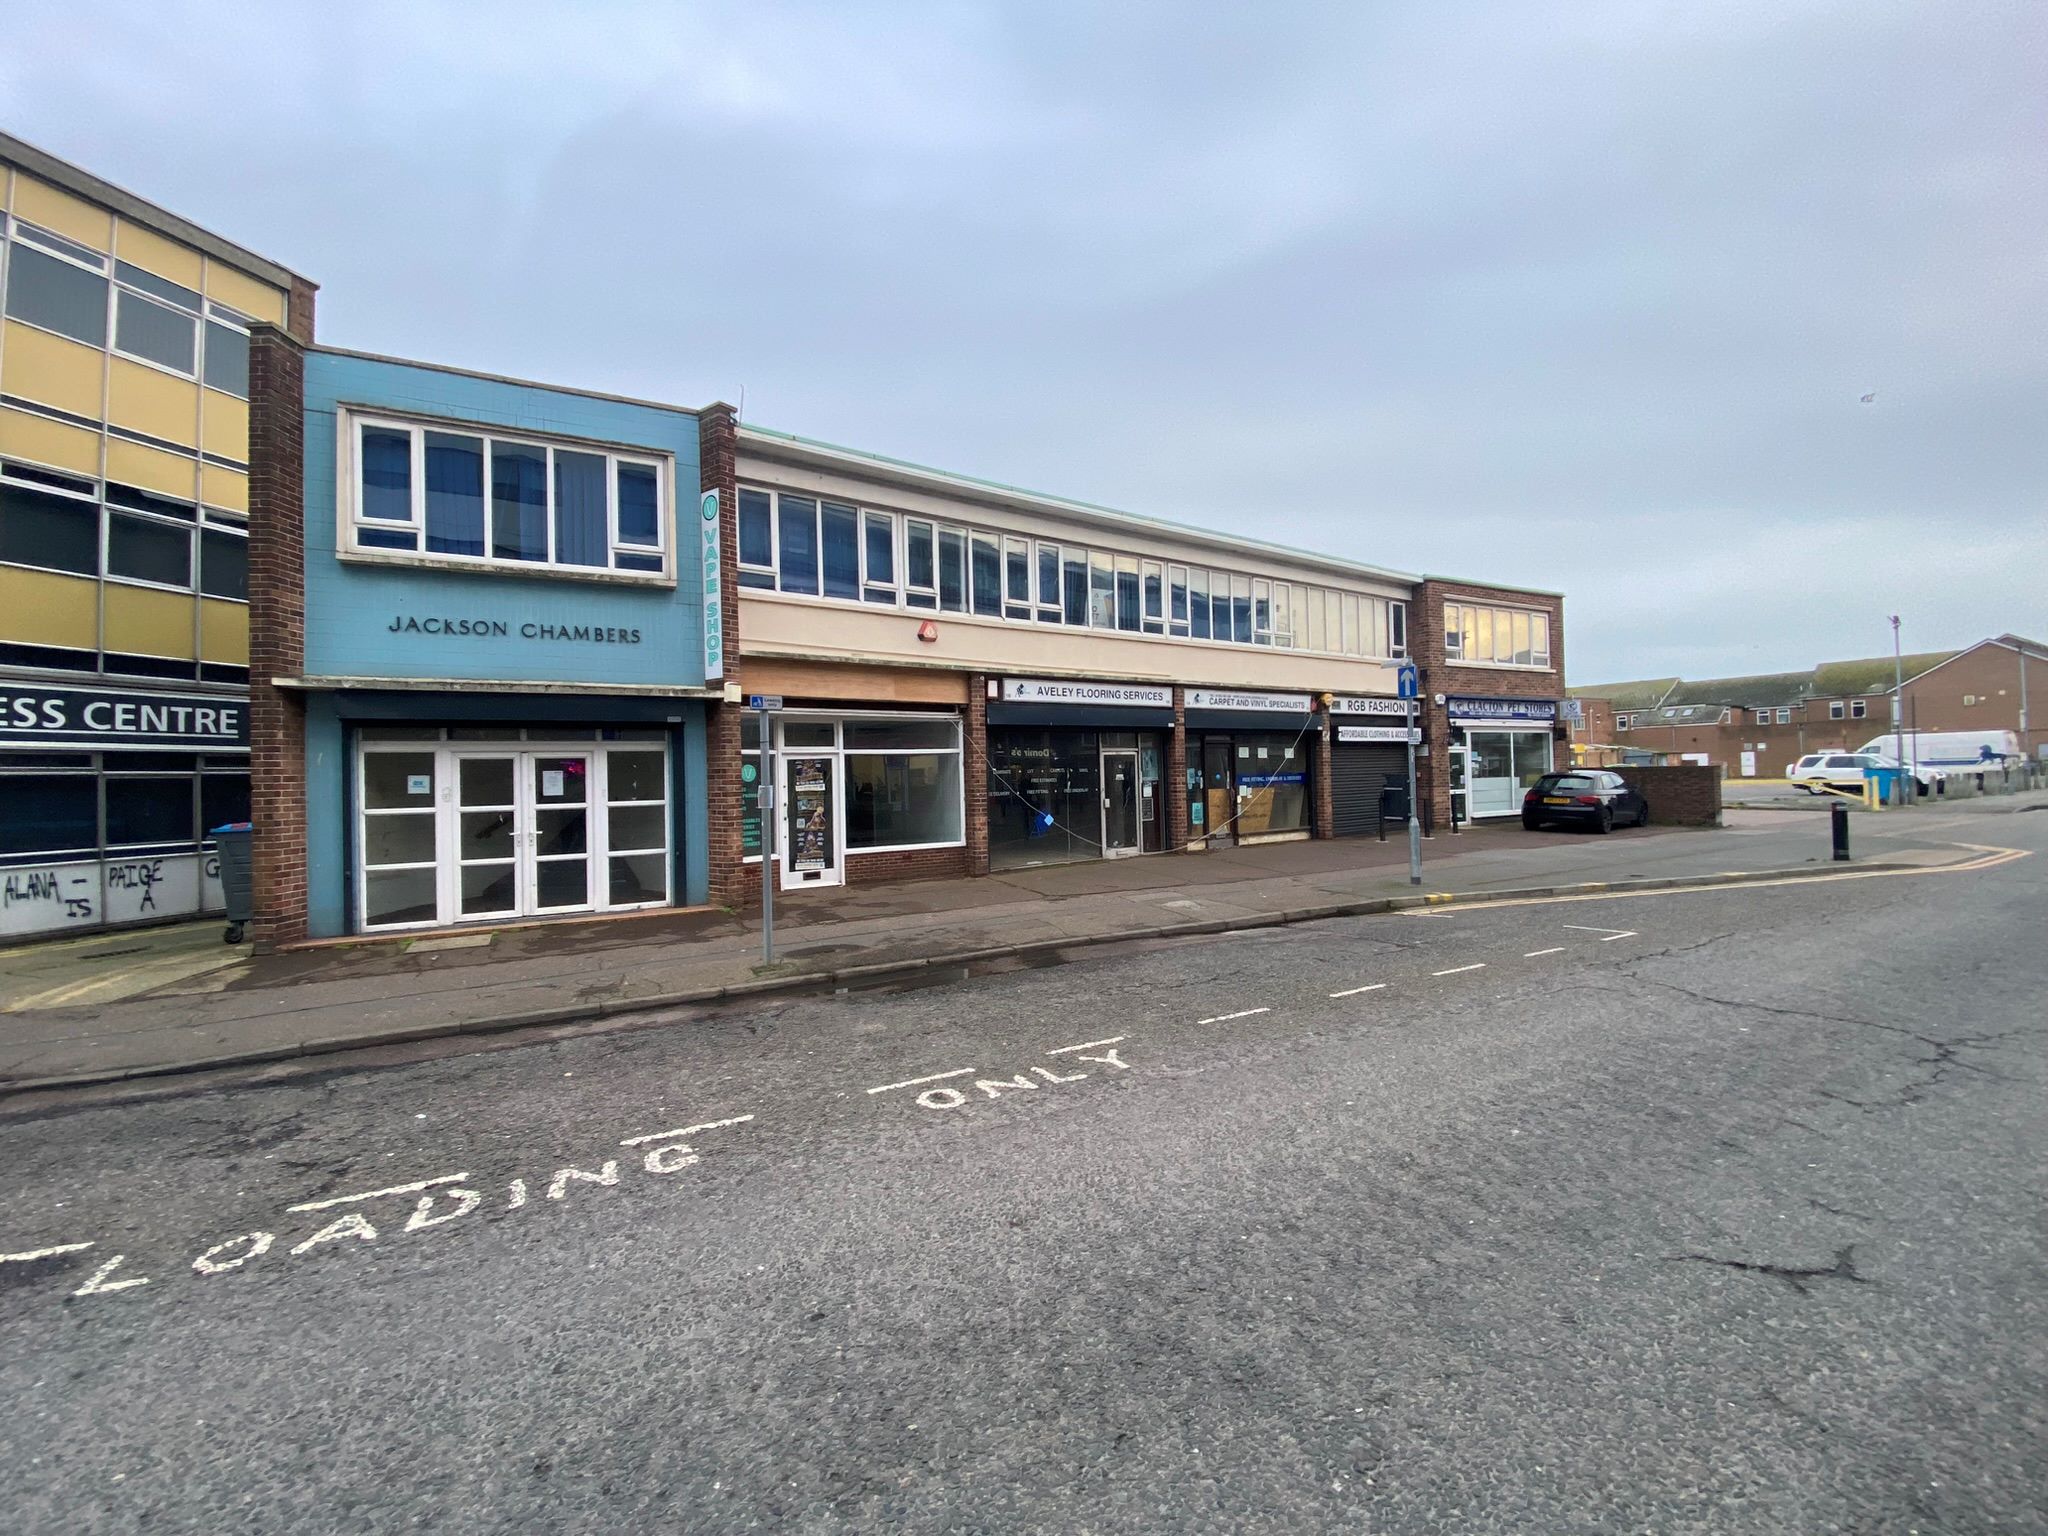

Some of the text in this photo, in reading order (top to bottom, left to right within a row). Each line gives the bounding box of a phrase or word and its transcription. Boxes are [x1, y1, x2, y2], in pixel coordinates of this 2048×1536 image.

[704, 528, 720, 667] VAPE SHOP
[389, 616, 641, 644] JACKSON CHAMBERS
[1037, 687, 1163, 701] AVELEY FLOORING SERVICES
[1209, 697, 1305, 709] CARPET AND VINYL SPECIALISTS
[1347, 700, 1405, 713] RGB FASHION
[1467, 700, 1552, 713] CLACTON PET STORES
[83, 702, 239, 734] CENTRE
[4, 872, 62, 908] ALANA
[65, 889, 156, 918] IS A
[74, 1050, 1131, 1296] LOADING ONLY
